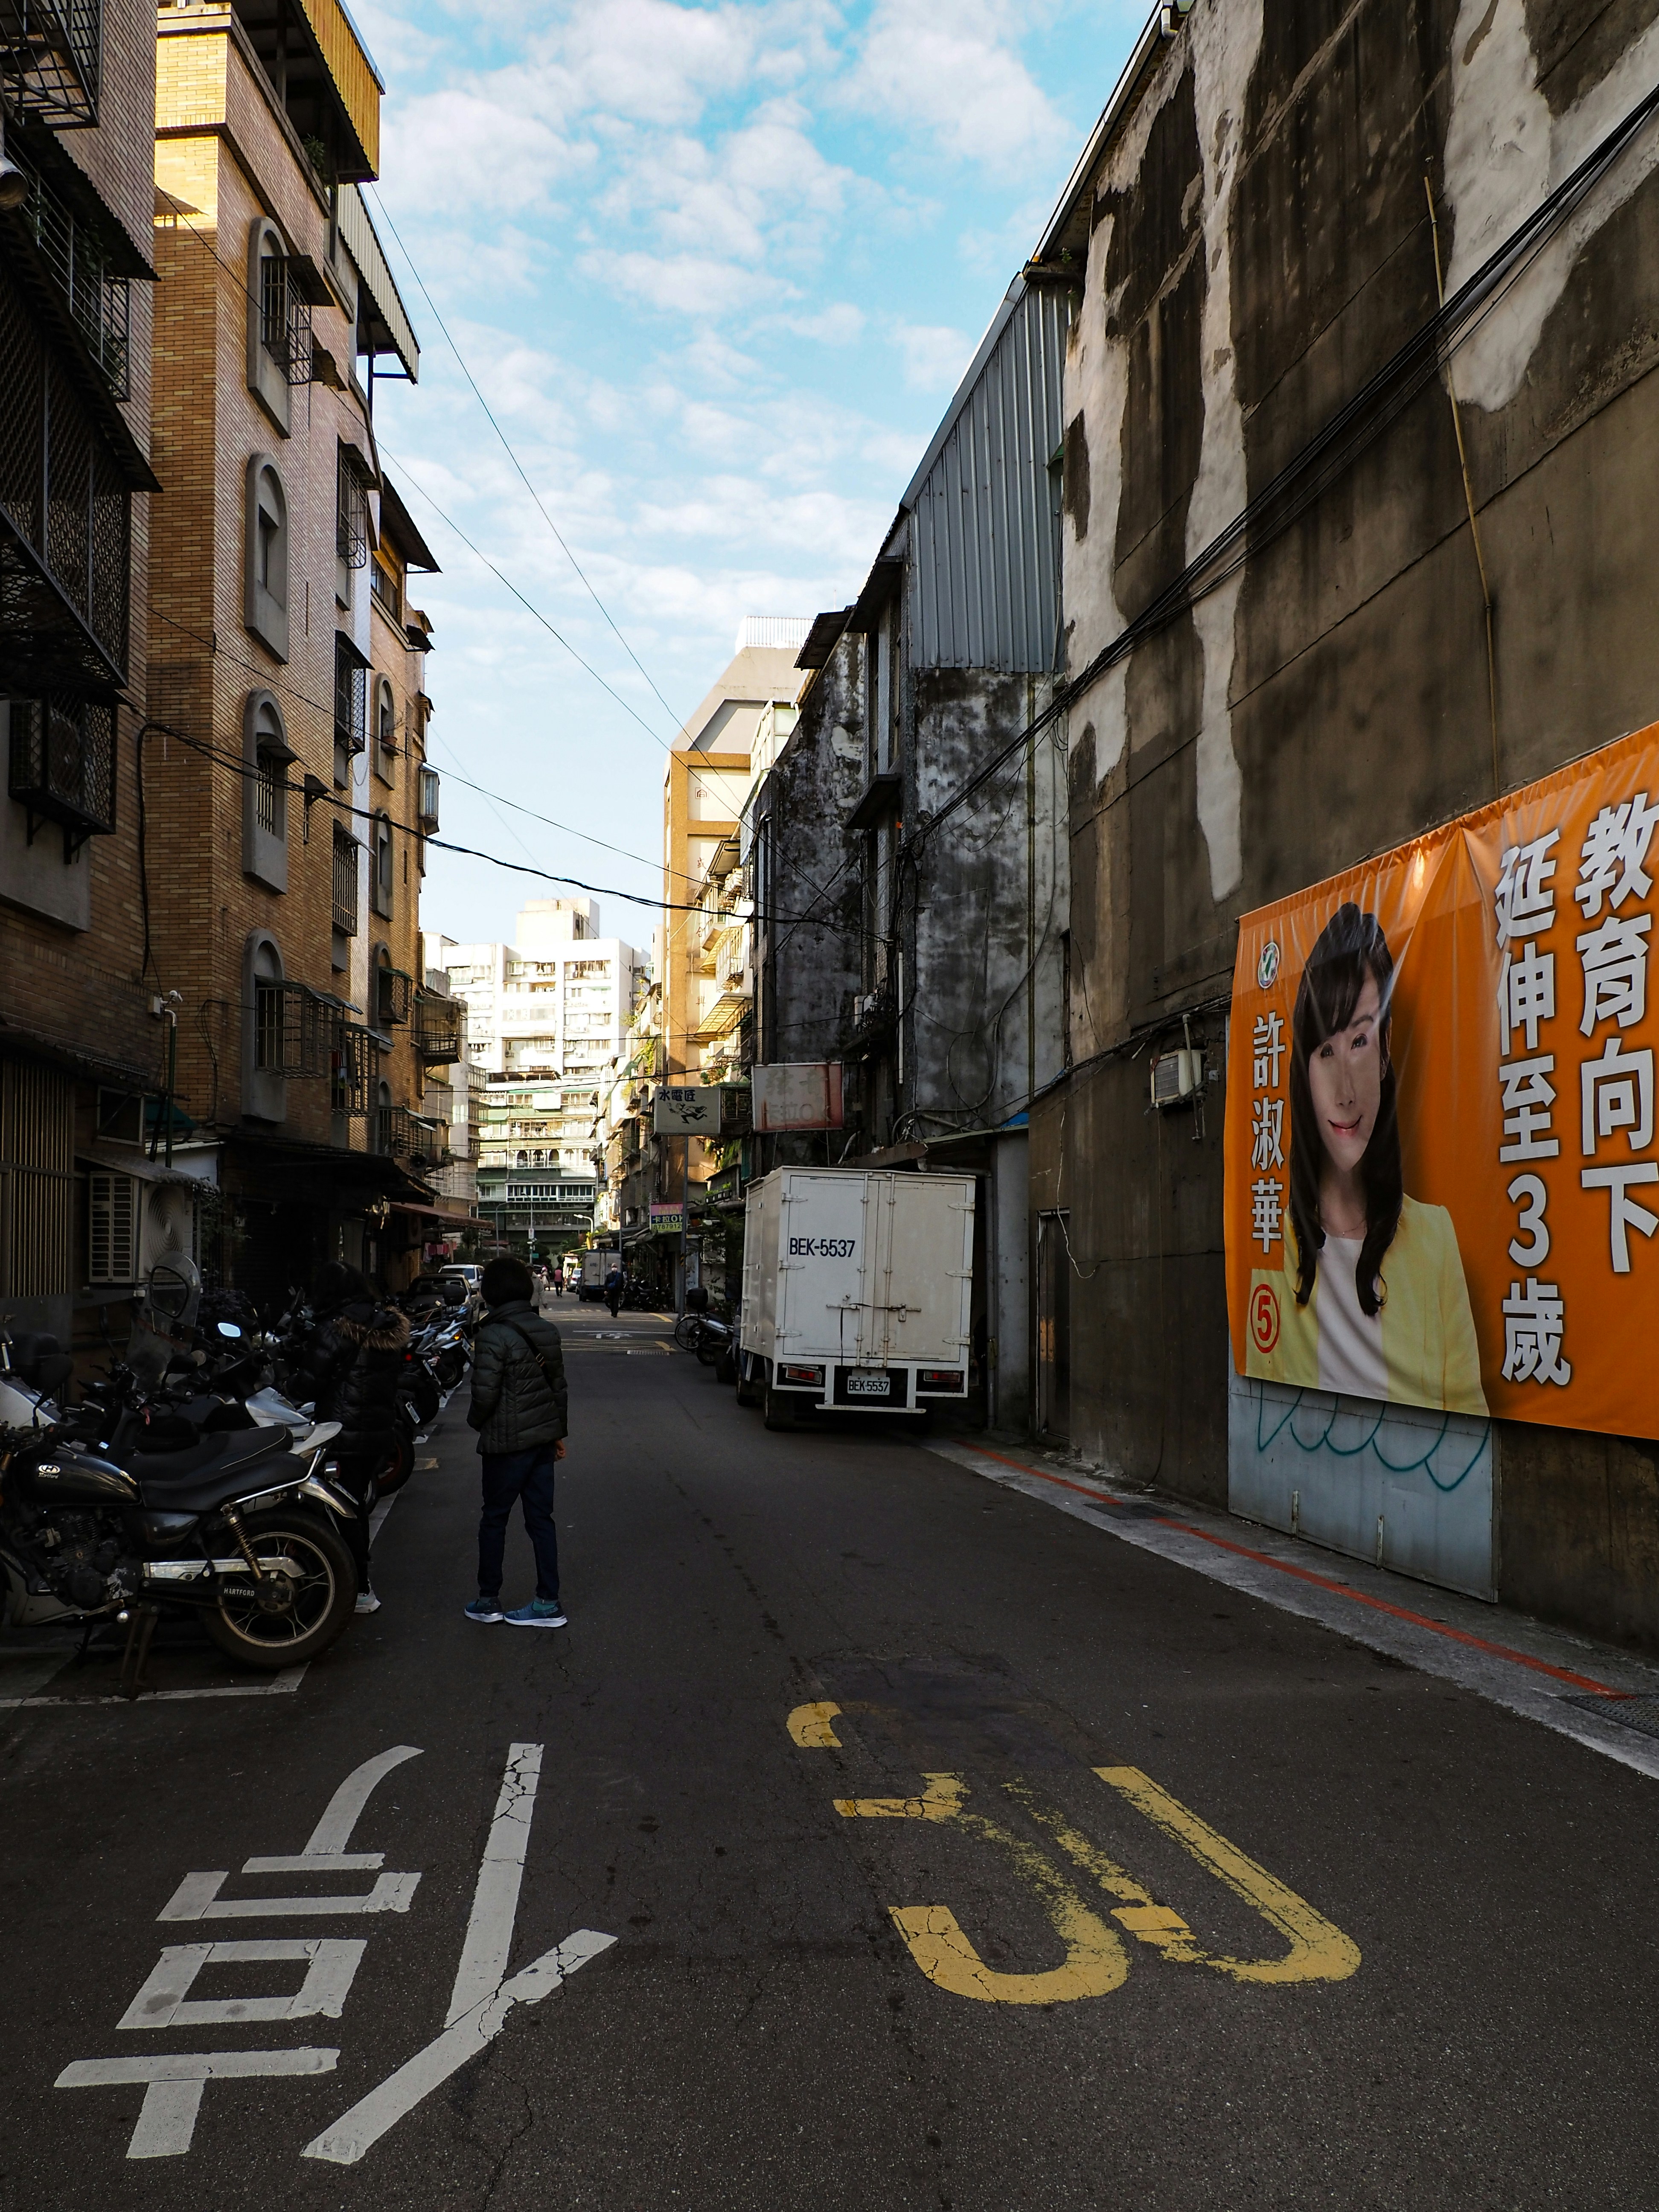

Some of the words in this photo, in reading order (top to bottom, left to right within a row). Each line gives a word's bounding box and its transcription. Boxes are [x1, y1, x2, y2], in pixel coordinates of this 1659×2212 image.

[1575, 792, 1659, 1272] 教育向下
[658, 1089, 696, 1102] 水電匠
[1494, 828, 1571, 1386] 延伸至3歲
[1251, 1011, 1285, 1253] 許淑華
[789, 1237, 856, 1257] BEK-5537
[848, 1380, 889, 1392] BEK-5537
[224, 1587, 255, 1597] HARTFORD
